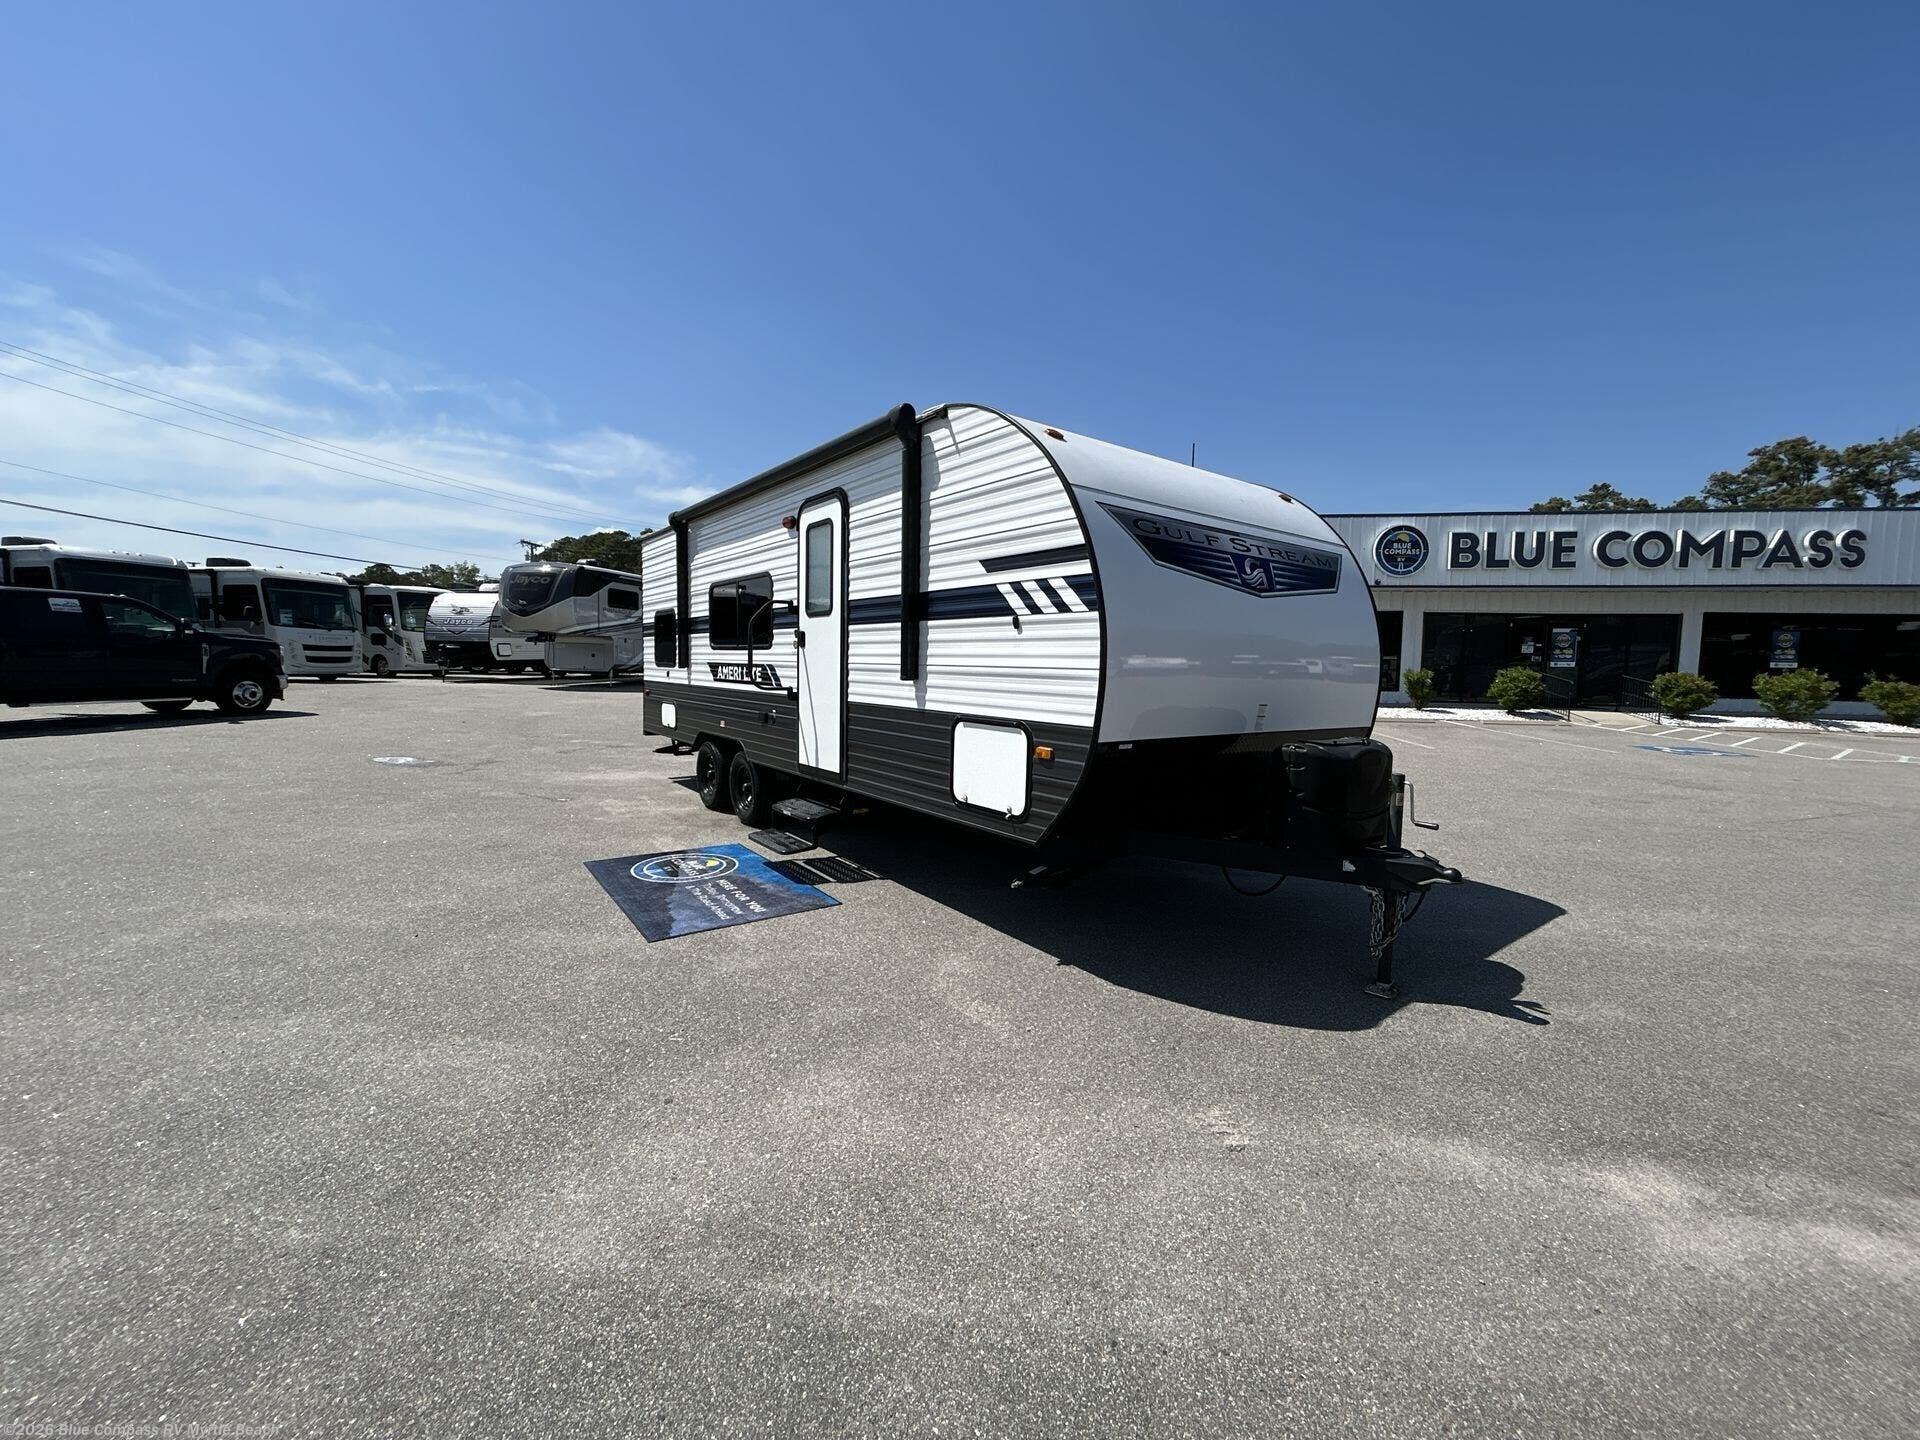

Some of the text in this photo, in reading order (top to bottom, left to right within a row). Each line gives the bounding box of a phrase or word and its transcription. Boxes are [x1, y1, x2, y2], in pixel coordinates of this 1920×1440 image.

[1132, 518, 1333, 569] GULF STREAM
[1448, 529, 1868, 570] BLUE COMPASS
[511, 574, 551, 585] Jayco
[443, 617, 473, 626] Jayco
[731, 890, 750, 901] FOR
[745, 900, 767, 912] YOU
